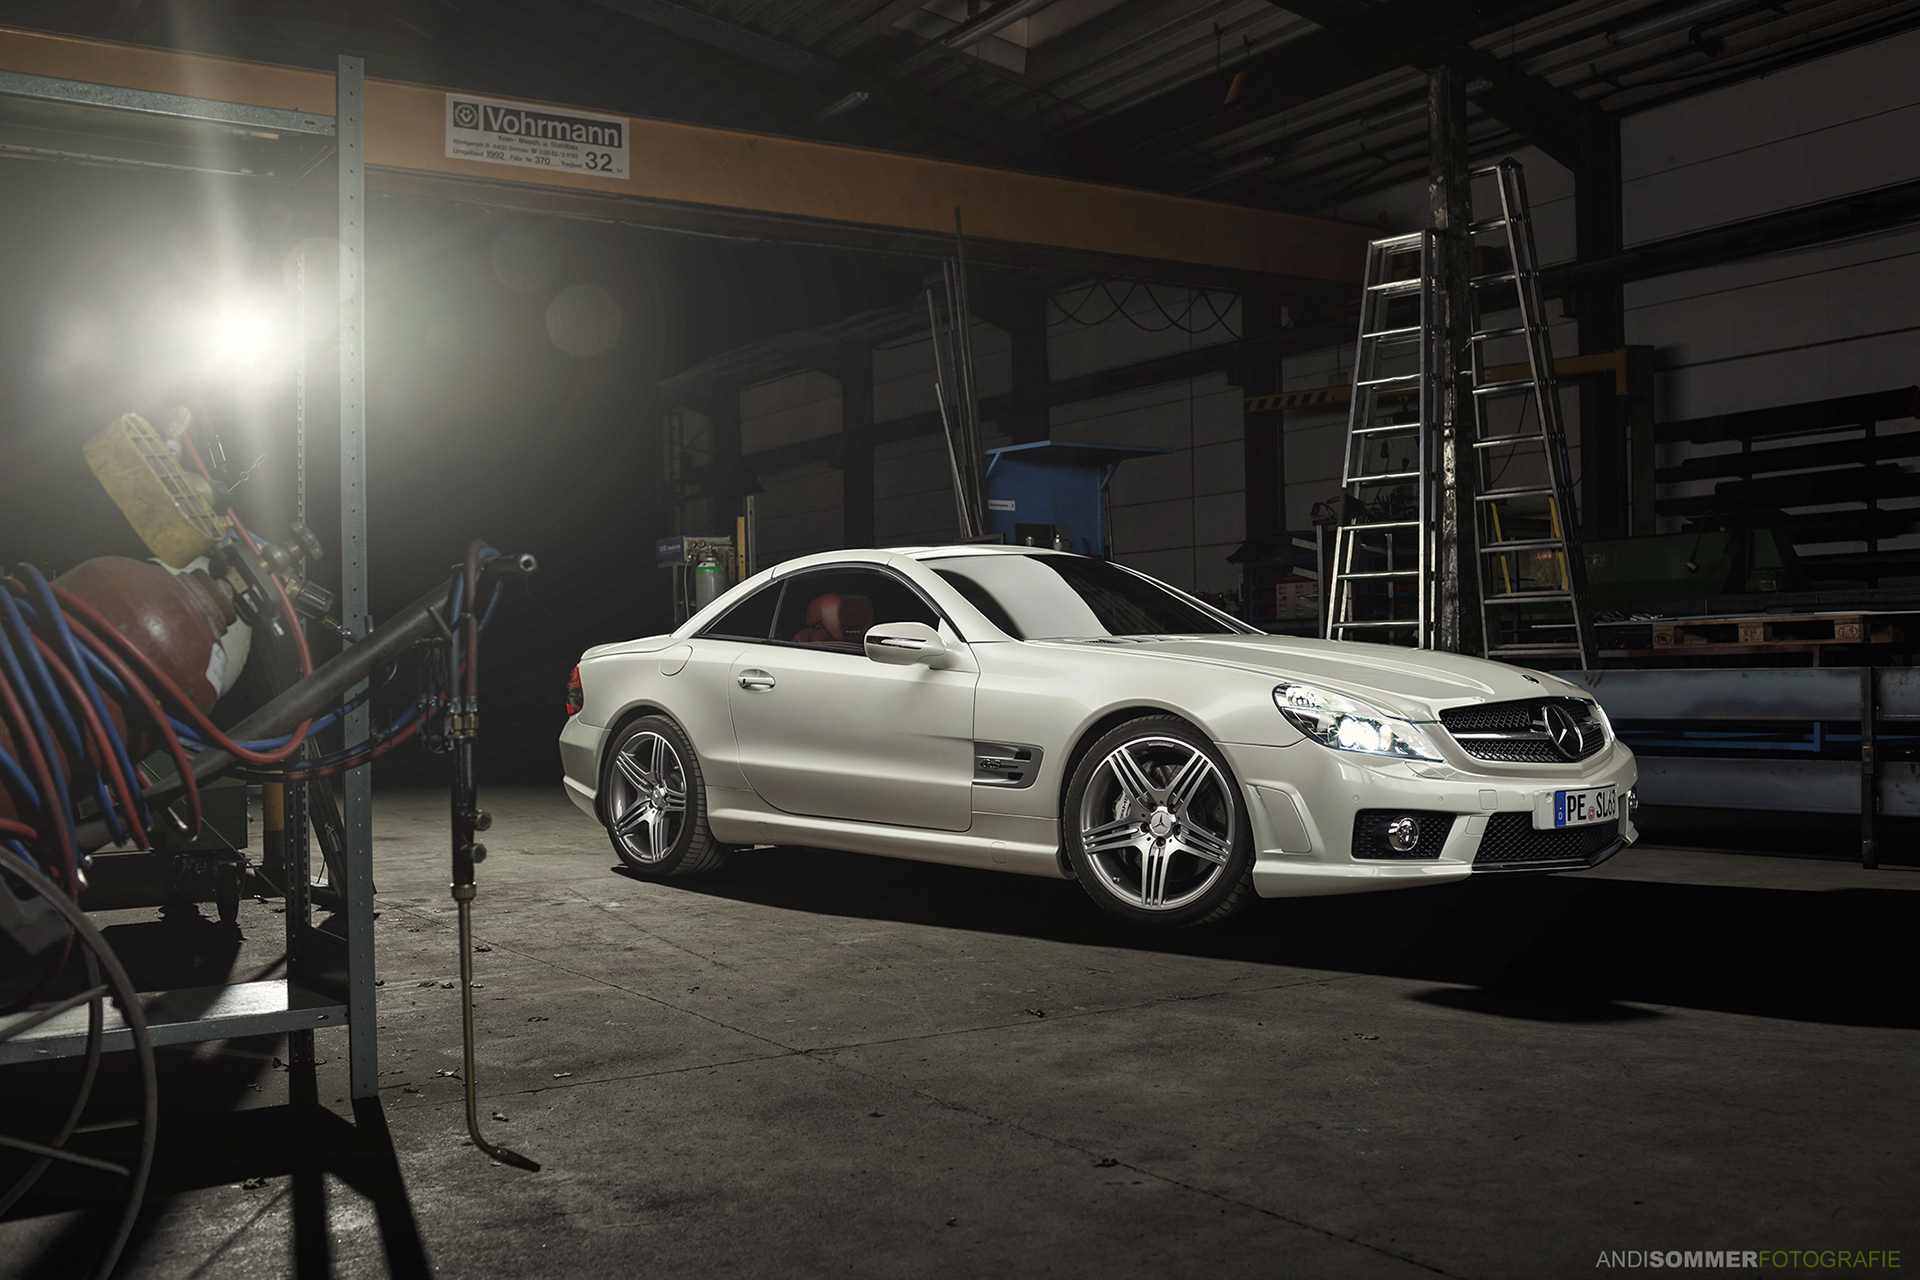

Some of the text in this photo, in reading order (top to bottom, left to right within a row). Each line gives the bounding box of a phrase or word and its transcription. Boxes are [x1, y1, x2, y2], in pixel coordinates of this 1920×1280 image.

[486, 106, 619, 147] Vohrmann
[486, 150, 505, 160] 1992
[535, 156, 551, 165] 370
[1567, 794, 1586, 821] PE
